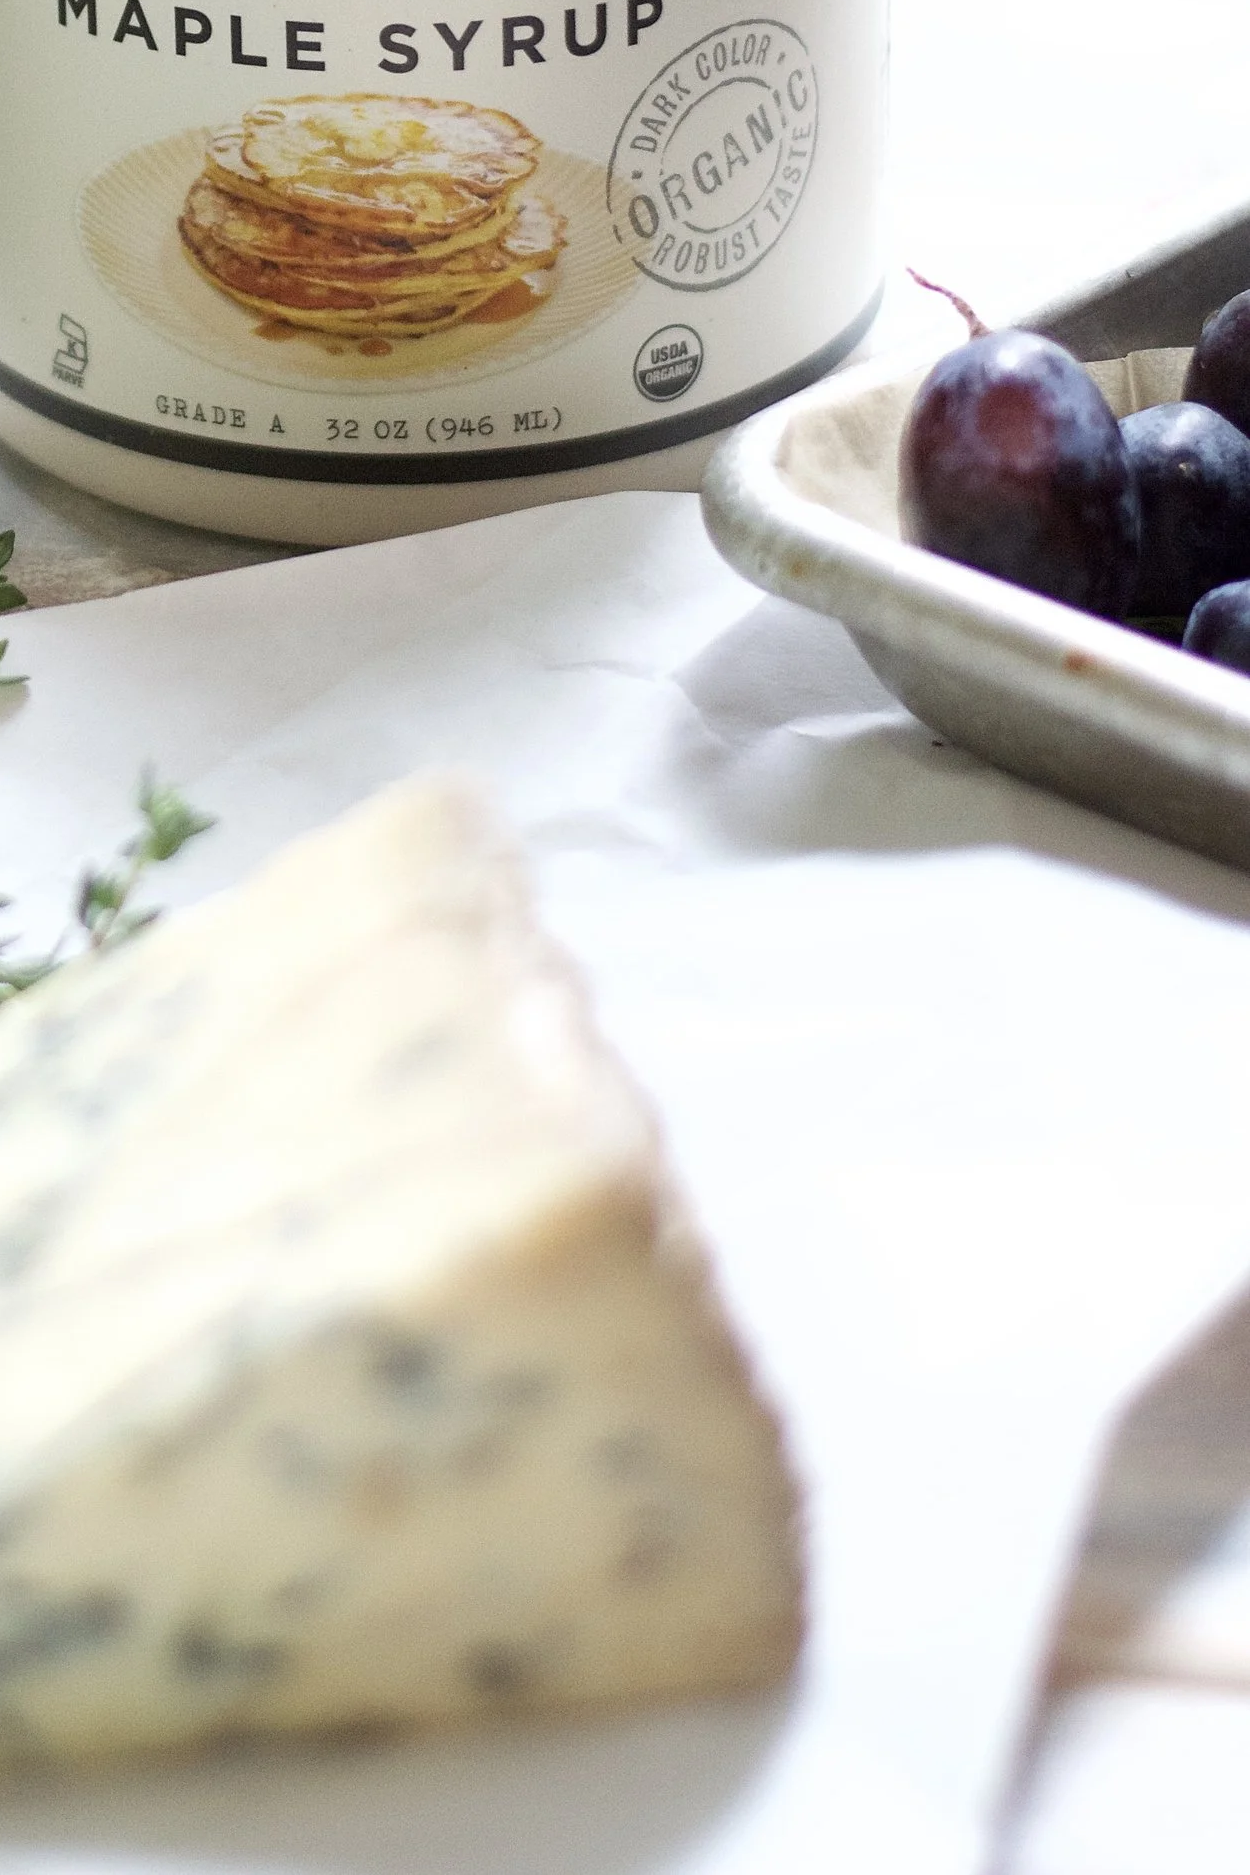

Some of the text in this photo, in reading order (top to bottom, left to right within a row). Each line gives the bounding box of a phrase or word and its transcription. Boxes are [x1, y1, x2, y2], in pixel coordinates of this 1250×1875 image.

[629, 33, 771, 153] DARK COLOR
[627, 68, 808, 240] ORGANIC
[652, 121, 812, 275] ROBUST TASTE
[644, 360, 695, 385] ORGANIC
[650, 341, 689, 365] USDA
[155, 394, 562, 443] GRADE A 32 OZ (946 ML)
